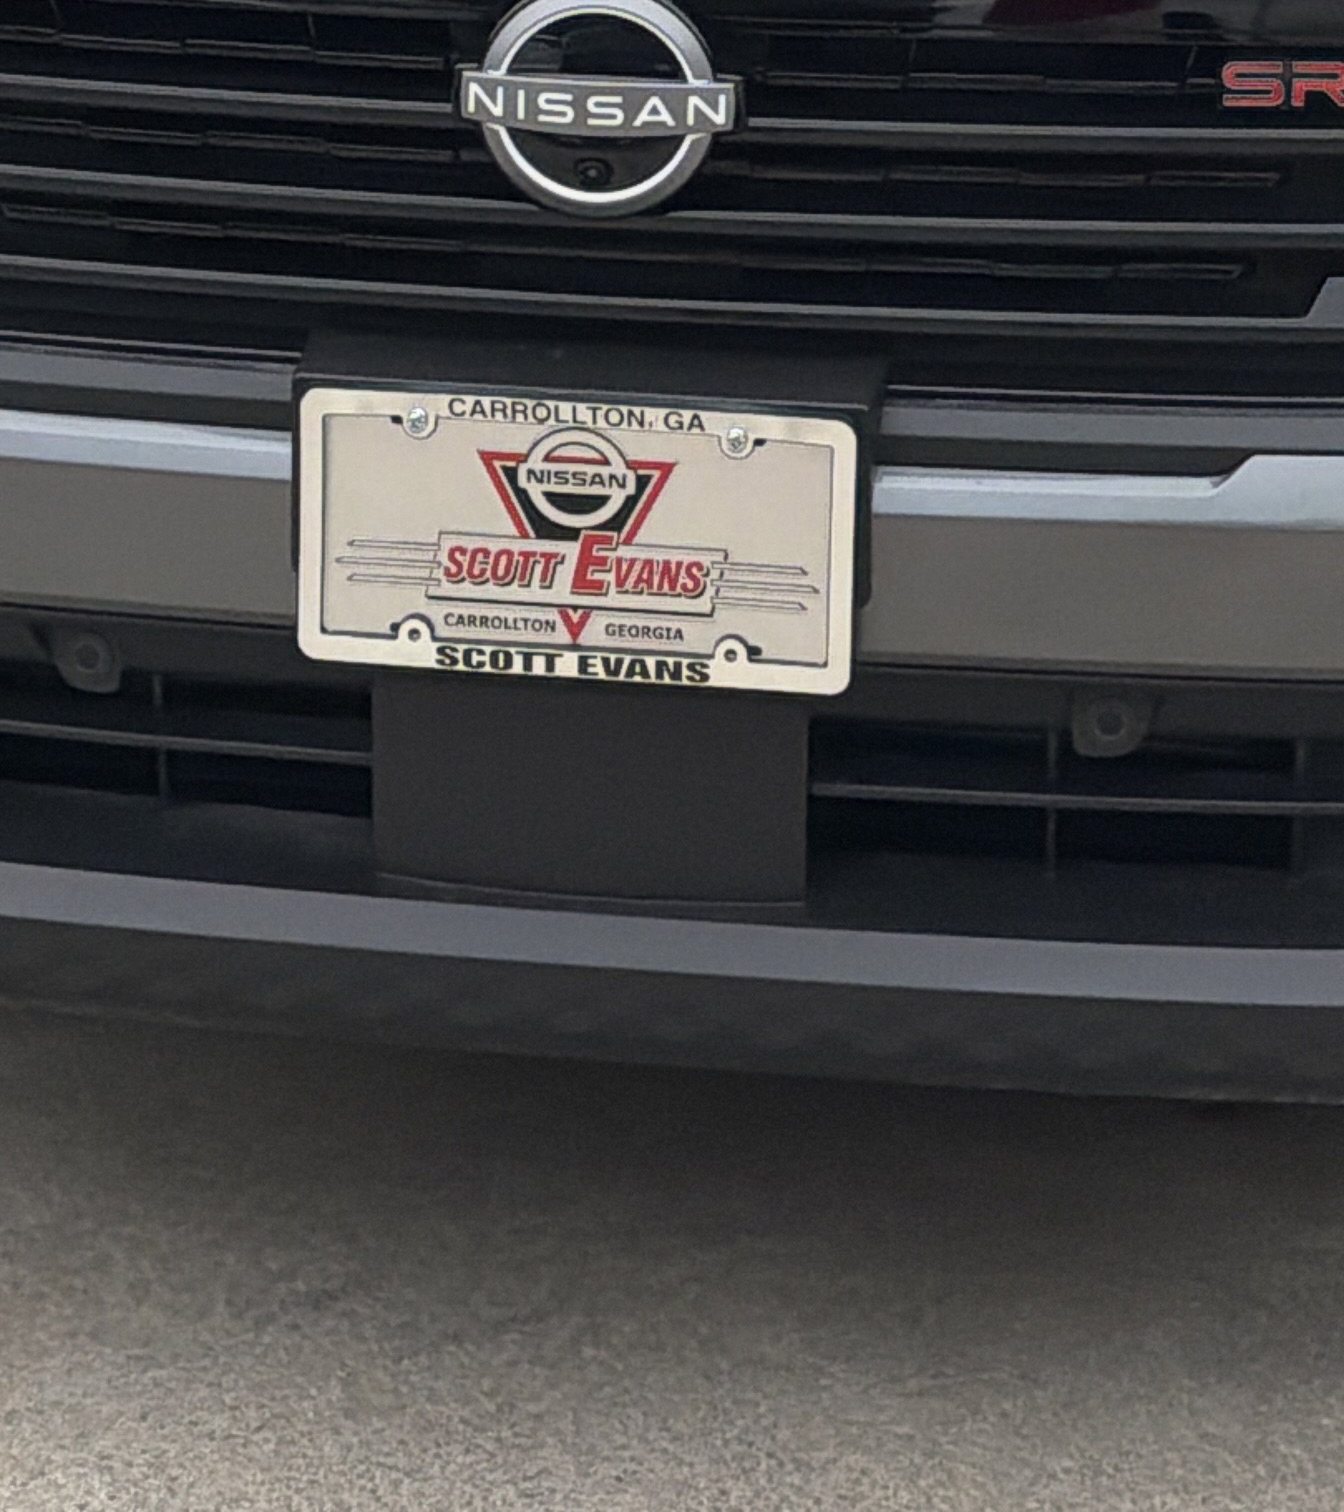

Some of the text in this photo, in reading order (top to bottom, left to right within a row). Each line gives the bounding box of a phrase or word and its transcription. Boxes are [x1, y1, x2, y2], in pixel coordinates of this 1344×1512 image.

[466, 81, 728, 127] NISSAN
[663, 409, 706, 433] GA
[525, 467, 628, 490] NISSAN
[443, 531, 711, 598] SCOTT EVANS
[443, 612, 685, 642] CARROLLTON GEORGIA
[434, 644, 711, 684] SCOTT EVANS
